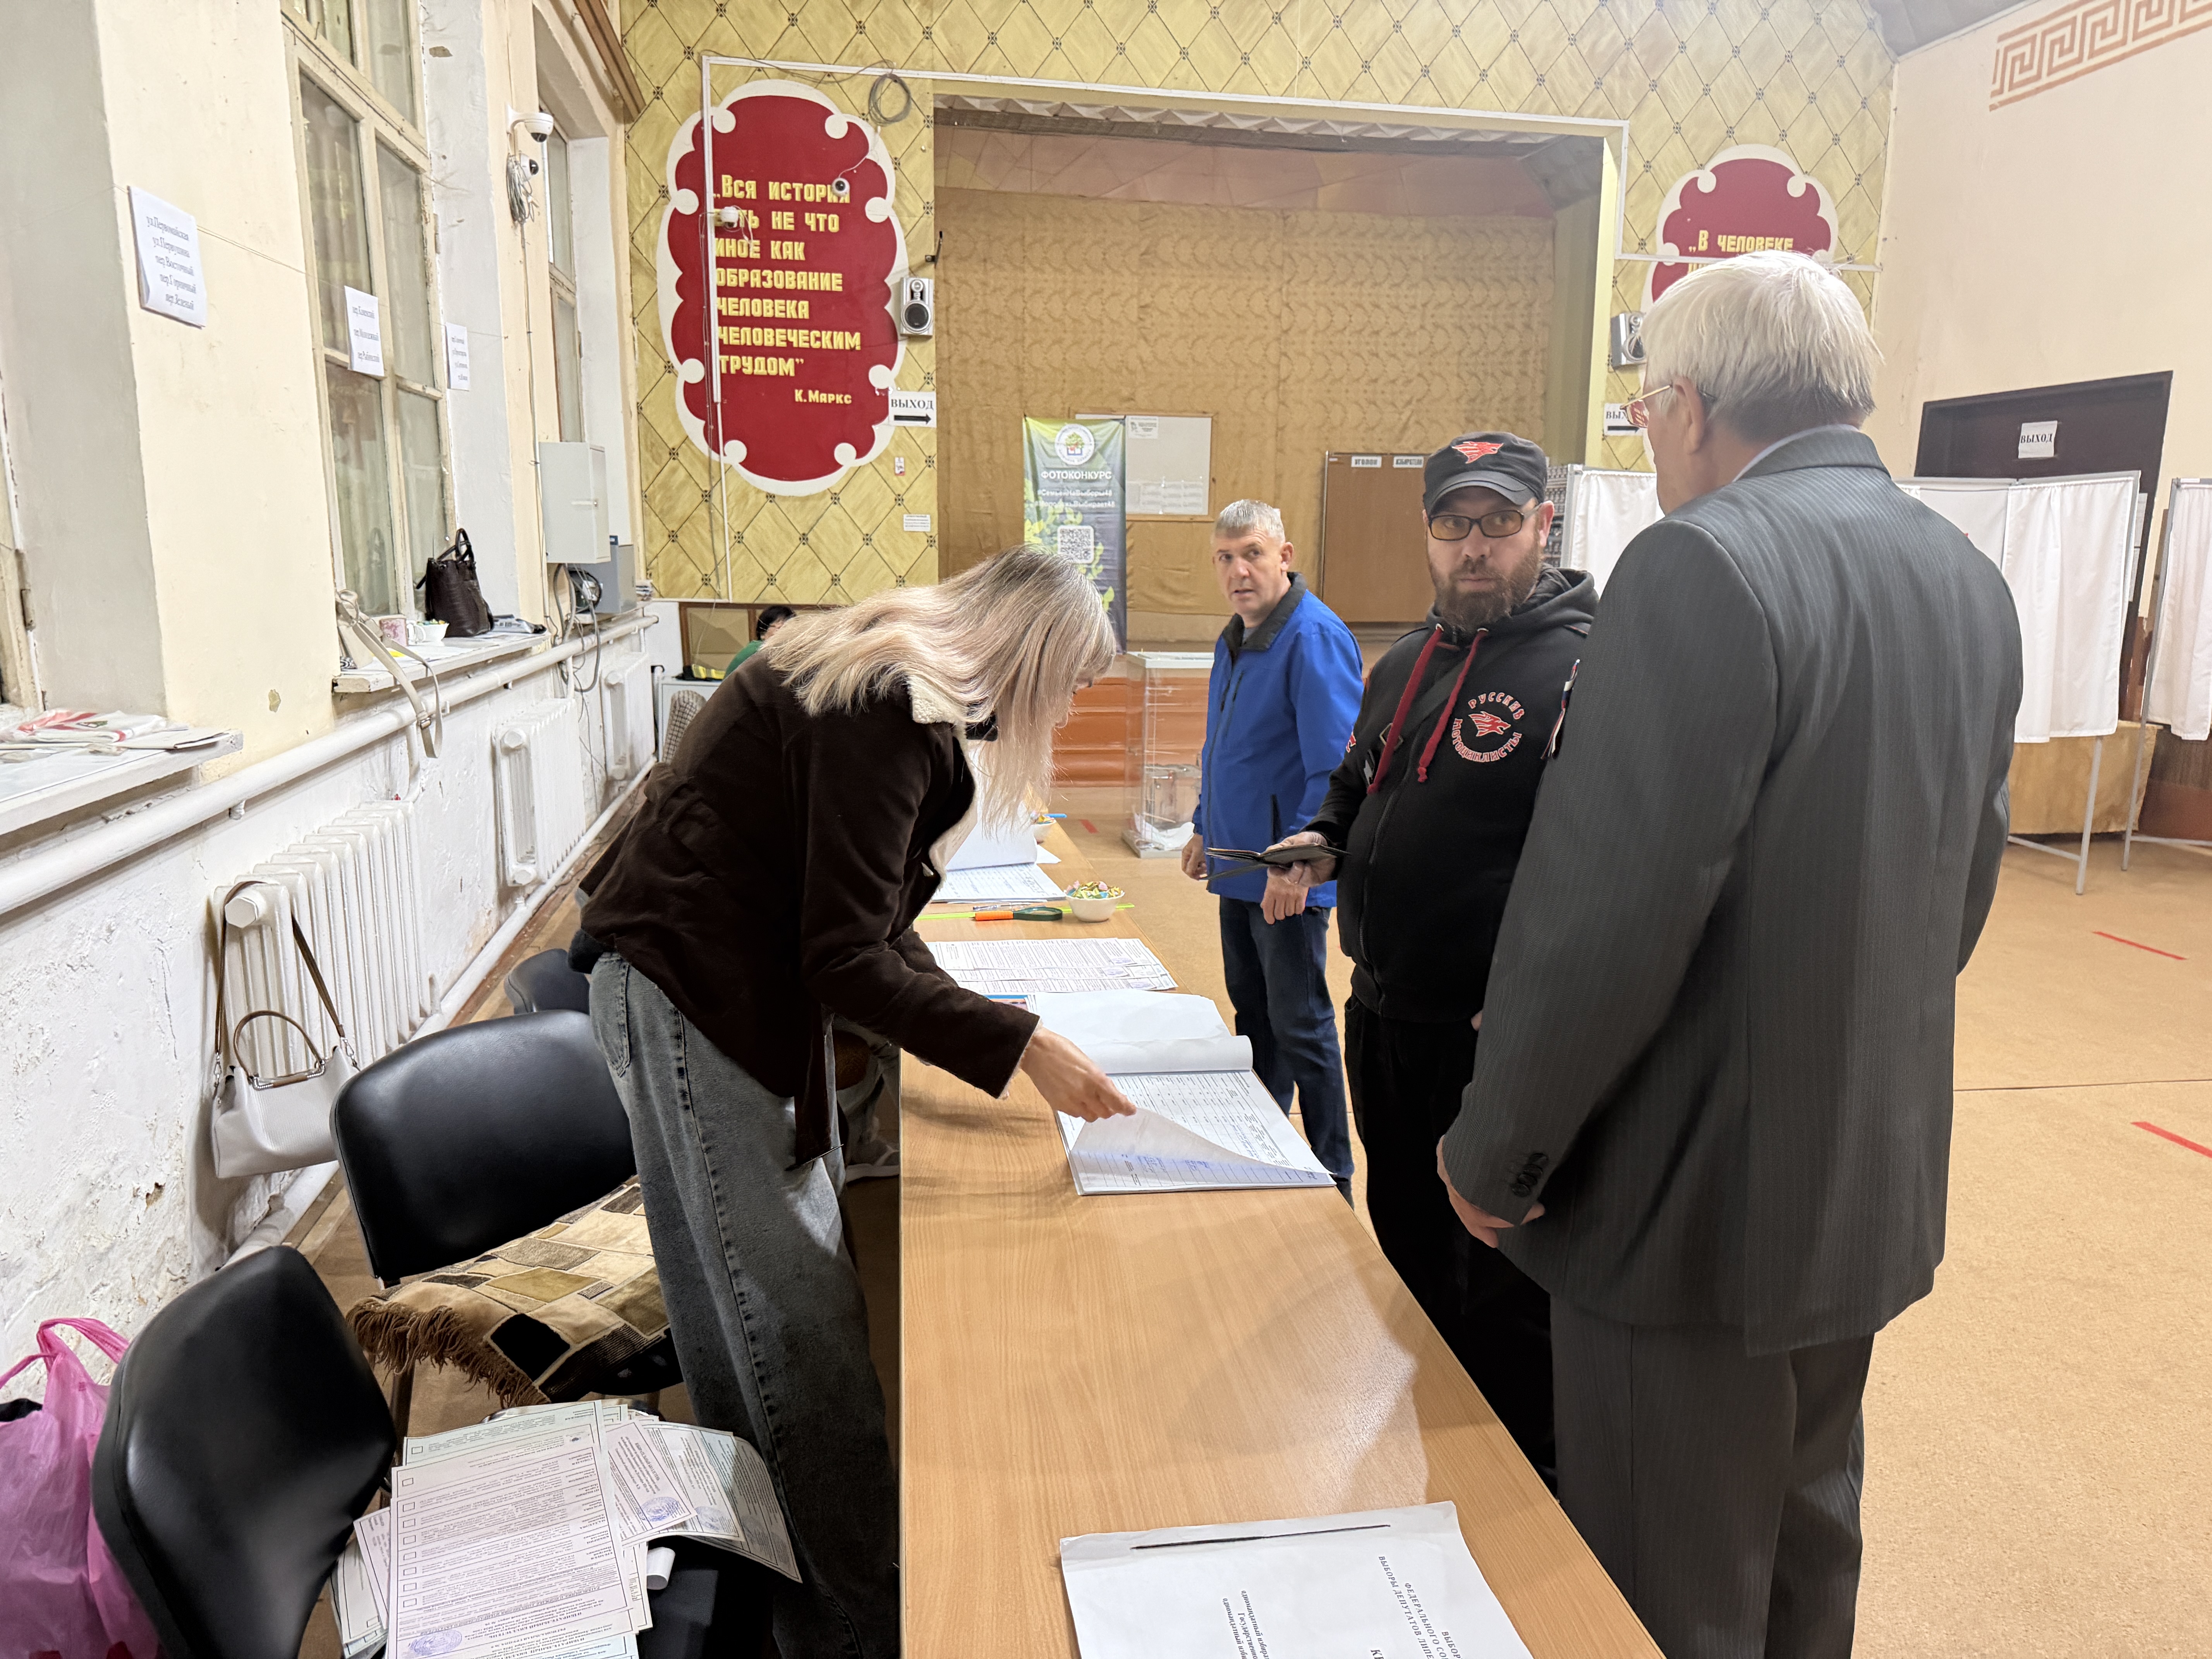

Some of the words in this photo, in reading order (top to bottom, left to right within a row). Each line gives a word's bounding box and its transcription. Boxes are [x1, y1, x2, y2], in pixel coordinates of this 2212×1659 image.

[713, 208, 759, 229] ЕТЬ
[771, 211, 794, 230] НЕ
[805, 212, 839, 232] ЧТО
[715, 238, 761, 259] ИНОЕ
[771, 240, 805, 261] КАК
[716, 268, 843, 291] ОБРАЗОВАНИЕ
[717, 297, 809, 319] ЧЕЛОВЕКА
[718, 326, 861, 350] ЧЕЛОВЕЧЕСКИМ
[891, 399, 934, 410] ВЫХОД
[2021, 433, 2053, 443] ВЫХОД
[1041, 471, 1112, 479] ФОТОКОНКУРС
[1451, 718, 1522, 763] МОТОЦИКЛИСТЫ
[1379, 1556, 1399, 1588] ВЫБОРЫ
[1393, 1589, 1422, 1636] ДЕПУТАТОВ
[1223, 1598, 1244, 1644] одномандатный
[1241, 1590, 1263, 1636] одномандатный
[1405, 1583, 1440, 1645] ФЕДЕРАЛЬНОГО
